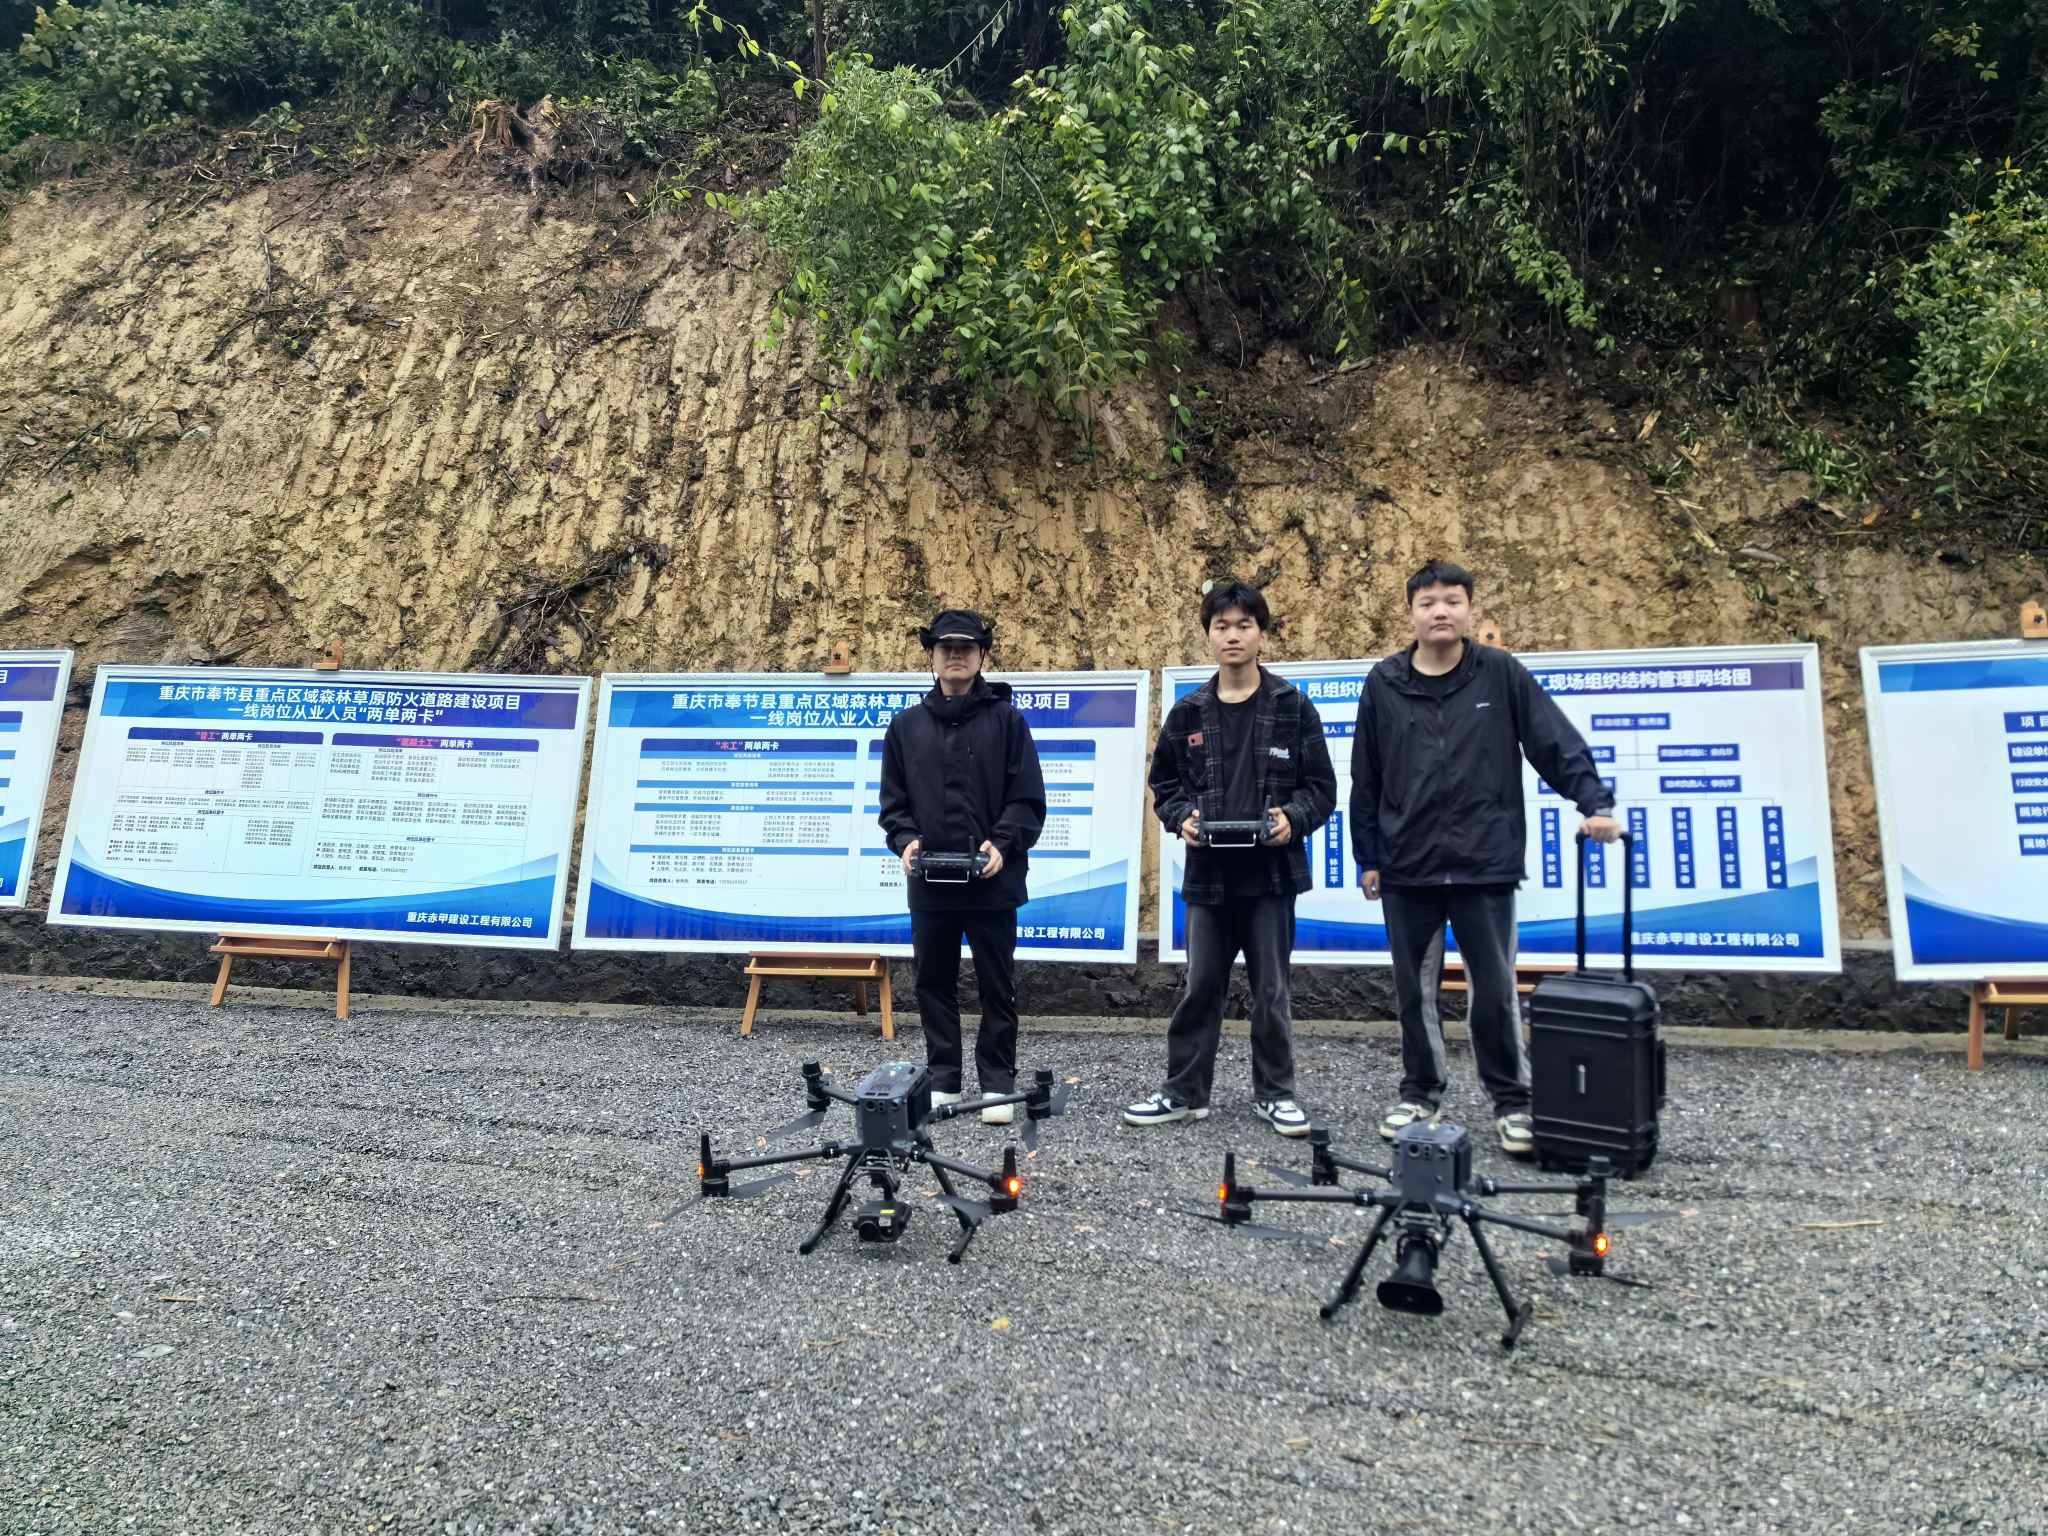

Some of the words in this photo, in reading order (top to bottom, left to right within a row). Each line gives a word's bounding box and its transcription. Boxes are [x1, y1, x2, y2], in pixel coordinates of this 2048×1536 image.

[159, 684, 521, 711] 重庆市奉节县重点区域森林草原防火道路建设项目
[406, 911, 533, 929] 重庆赤甲建设工程有限公司
